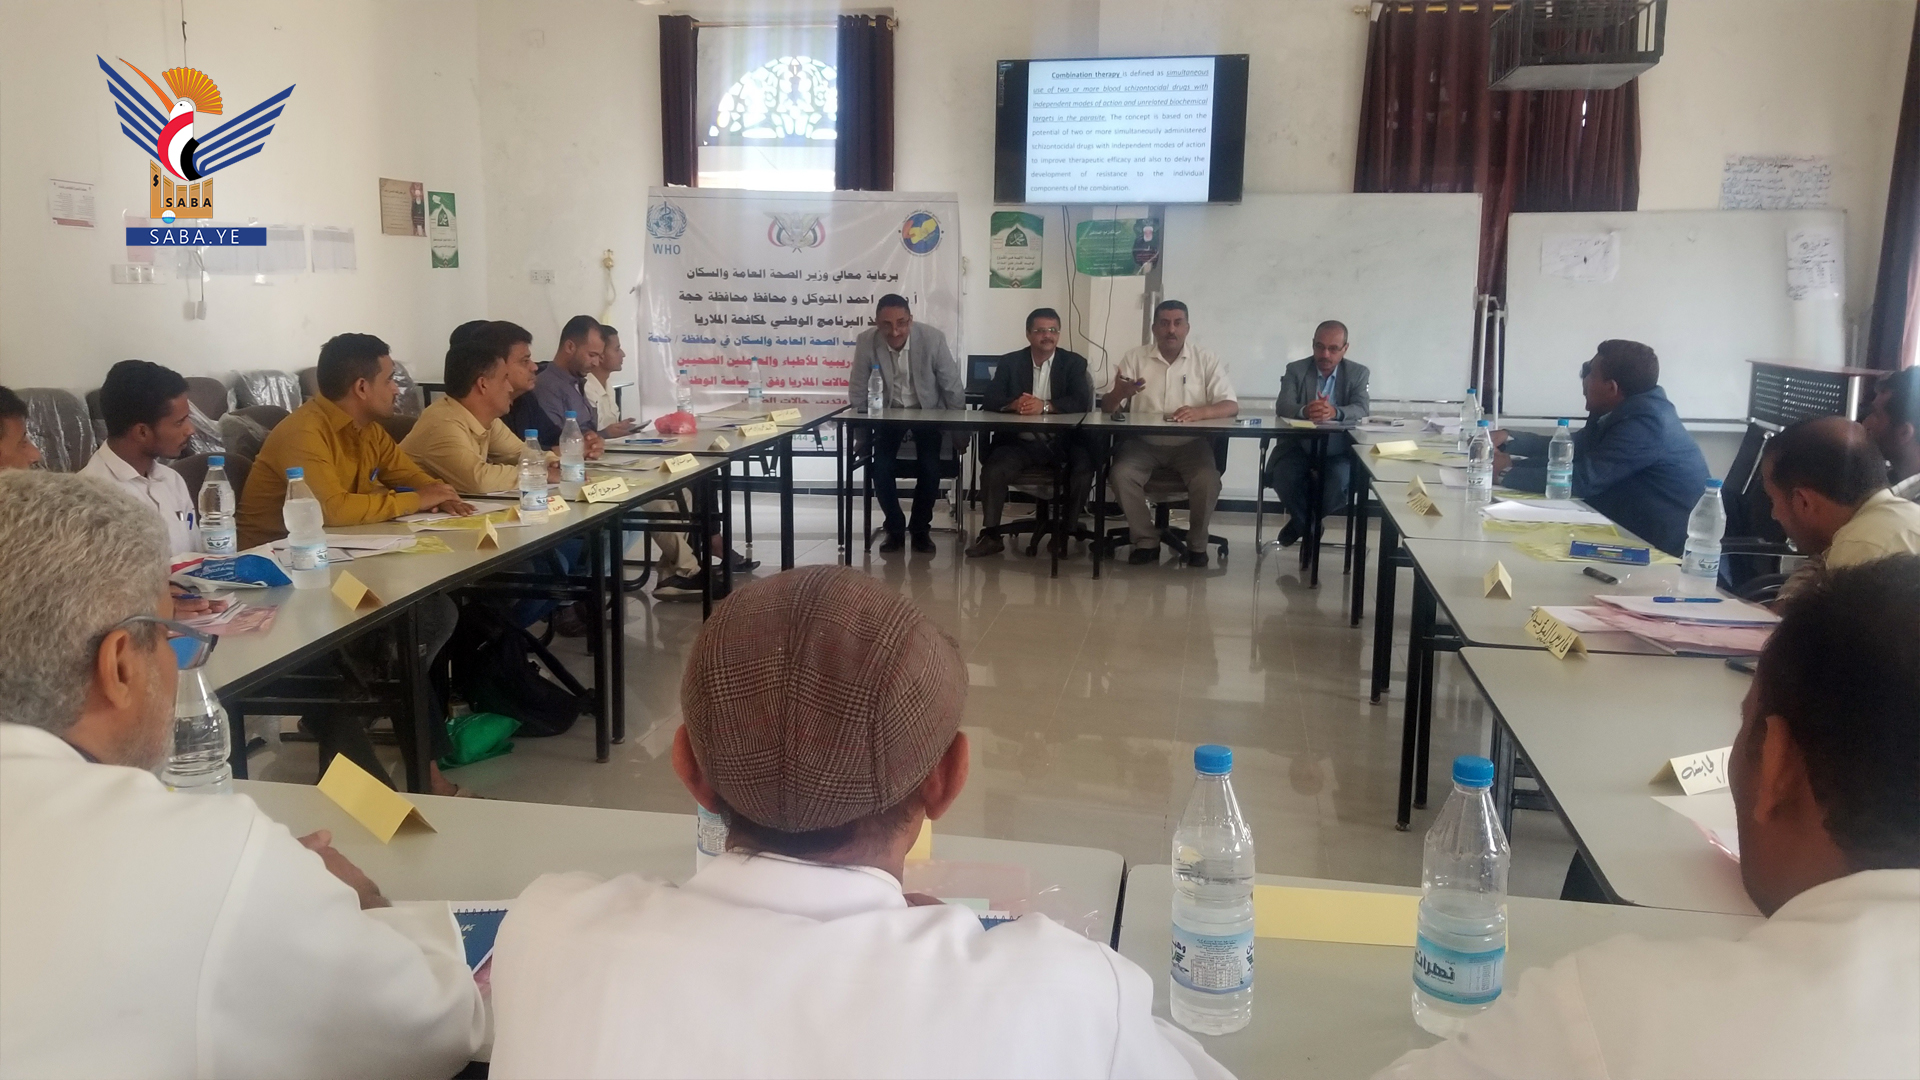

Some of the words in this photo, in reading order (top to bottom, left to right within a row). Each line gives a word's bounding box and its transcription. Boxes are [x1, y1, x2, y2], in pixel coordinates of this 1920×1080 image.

[1166, 69, 1209, 77] simultaneous
[1172, 84, 1190, 92] drugs
[1033, 100, 1071, 108] independent
[1095, 99, 1101, 107] of
[1125, 114, 1150, 122] concept
[1032, 129, 1059, 137] potential
[1069, 157, 1104, 165] therapeutic
[1107, 156, 1131, 164] efficacy
[1174, 156, 1191, 164] delay
[1031, 171, 1071, 179] development
[653, 243, 681, 255] WHO
[687, 267, 729, 279] والسكان
[732, 268, 766, 279] العامة
[770, 269, 802, 279] الصحة
[806, 270, 828, 281] وزير
[832, 269, 861, 281] معالي
[866, 270, 898, 282] برعاية
[679, 290, 702, 302] حجة
[708, 291, 748, 303] محافظة
[753, 292, 786, 304] محافظ
[791, 295, 798, 305] و
[802, 293, 841, 304] المتوكل
[847, 294, 873, 304] احمد
[695, 313, 727, 325] الملاريا
[731, 313, 766, 327] لمكافحة
[770, 315, 812, 328] الوطني
[817, 316, 864, 328] البرنامج
[681, 334, 716, 345] محافظة
[720, 337, 732, 347] في
[734, 335, 772, 346] والسكان
[775, 336, 806, 346] العامة
[810, 336, 840, 347] الصحة
[677, 354, 723, 367] الصحيين
[782, 356, 818, 368] للأطباء
[766, 375, 786, 388] وفق
[788, 376, 818, 388] الملاريا
